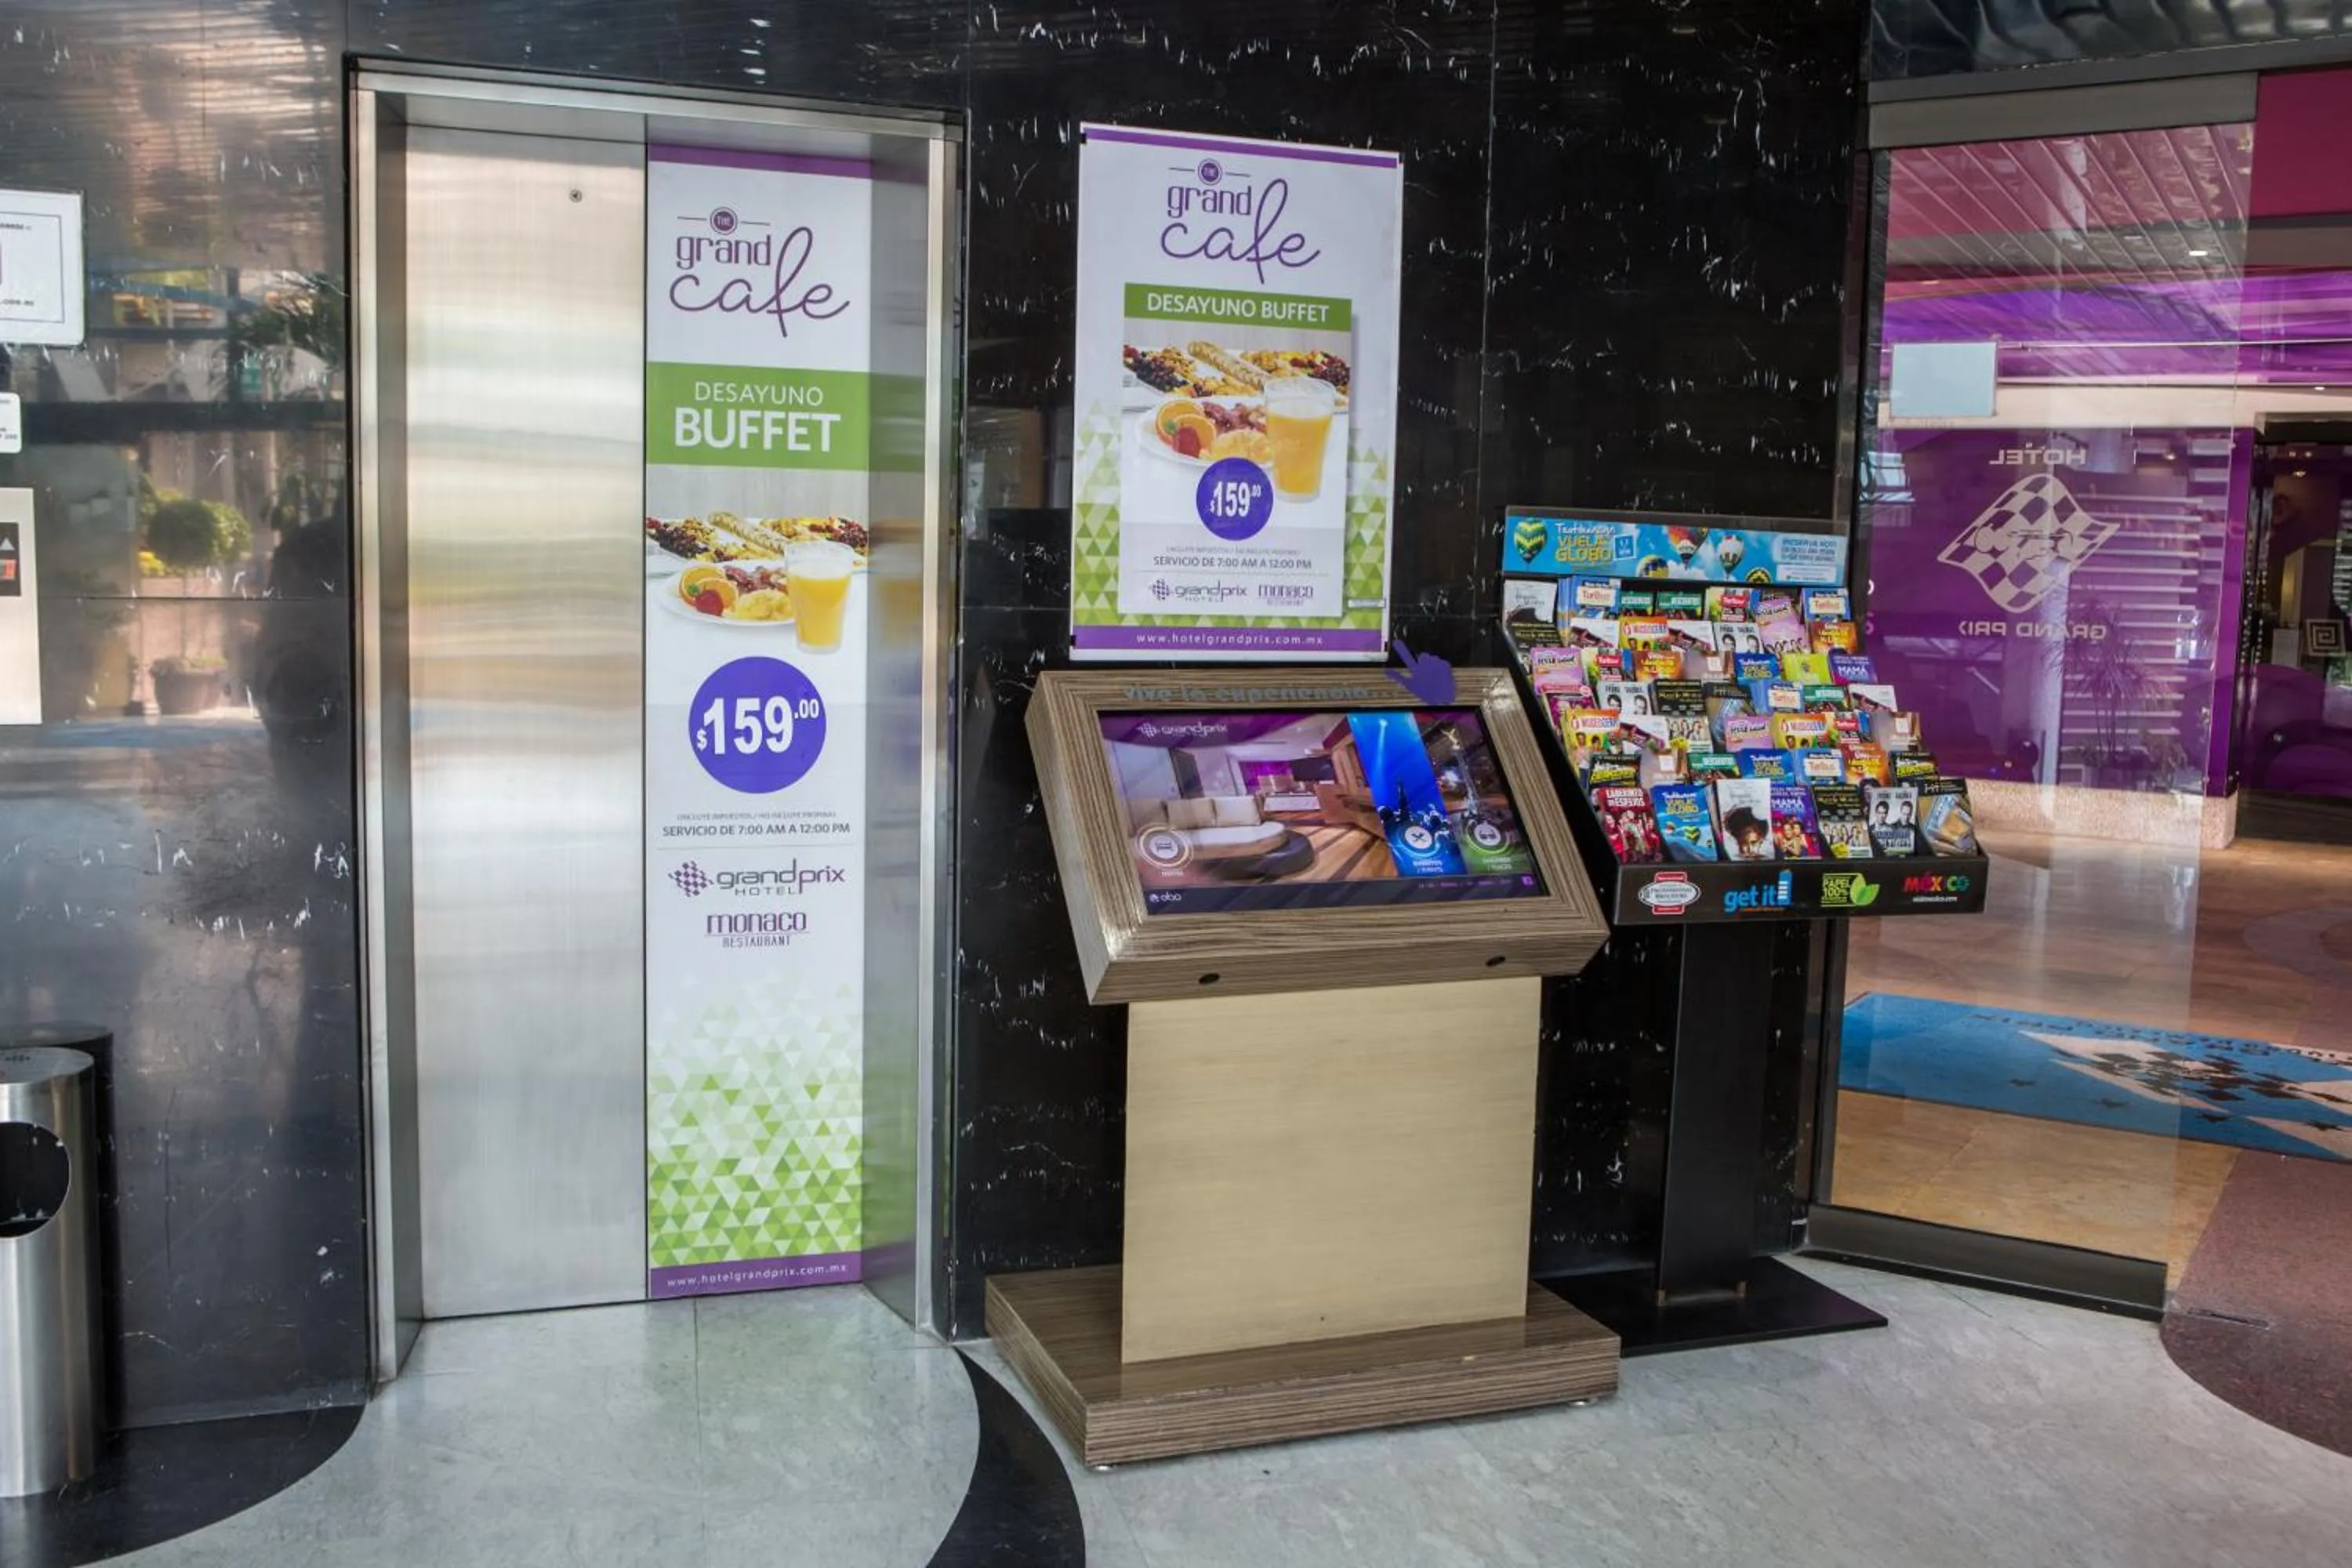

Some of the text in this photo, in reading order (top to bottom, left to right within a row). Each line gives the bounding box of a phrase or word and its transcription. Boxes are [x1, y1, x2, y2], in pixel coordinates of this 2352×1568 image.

[1167, 185, 1251, 218] grand
[1161, 178, 1321, 285] cafe
[677, 234, 771, 270] grand
[670, 226, 851, 338] cafe
[1147, 292, 1330, 322] DESAYUNO BUFFET
[695, 381, 823, 406] DESAYUNO
[675, 407, 841, 452] BUFFET
[1153, 555, 1199, 567] SERVICIO
[1202, 556, 1215, 567] DE
[1217, 557, 1239, 568] 7:00
[1241, 558, 1258, 568] AM
[1259, 559, 1267, 568] A
[1296, 560, 1312, 569] PM
[1258, 584, 1314, 599] monaco
[696, 695, 820, 756] $159.00
[662, 823, 851, 837] SERVICIO DE 7:00 AM A 12:00 PM
[735, 886, 797, 897] HOTEL
[1724, 884, 1758, 912] get
[706, 911, 808, 934] monaco
[722, 935, 791, 949] RESTAURANT
[666, 1264, 848, 1287] www.hotelgrandprix.com.mx
